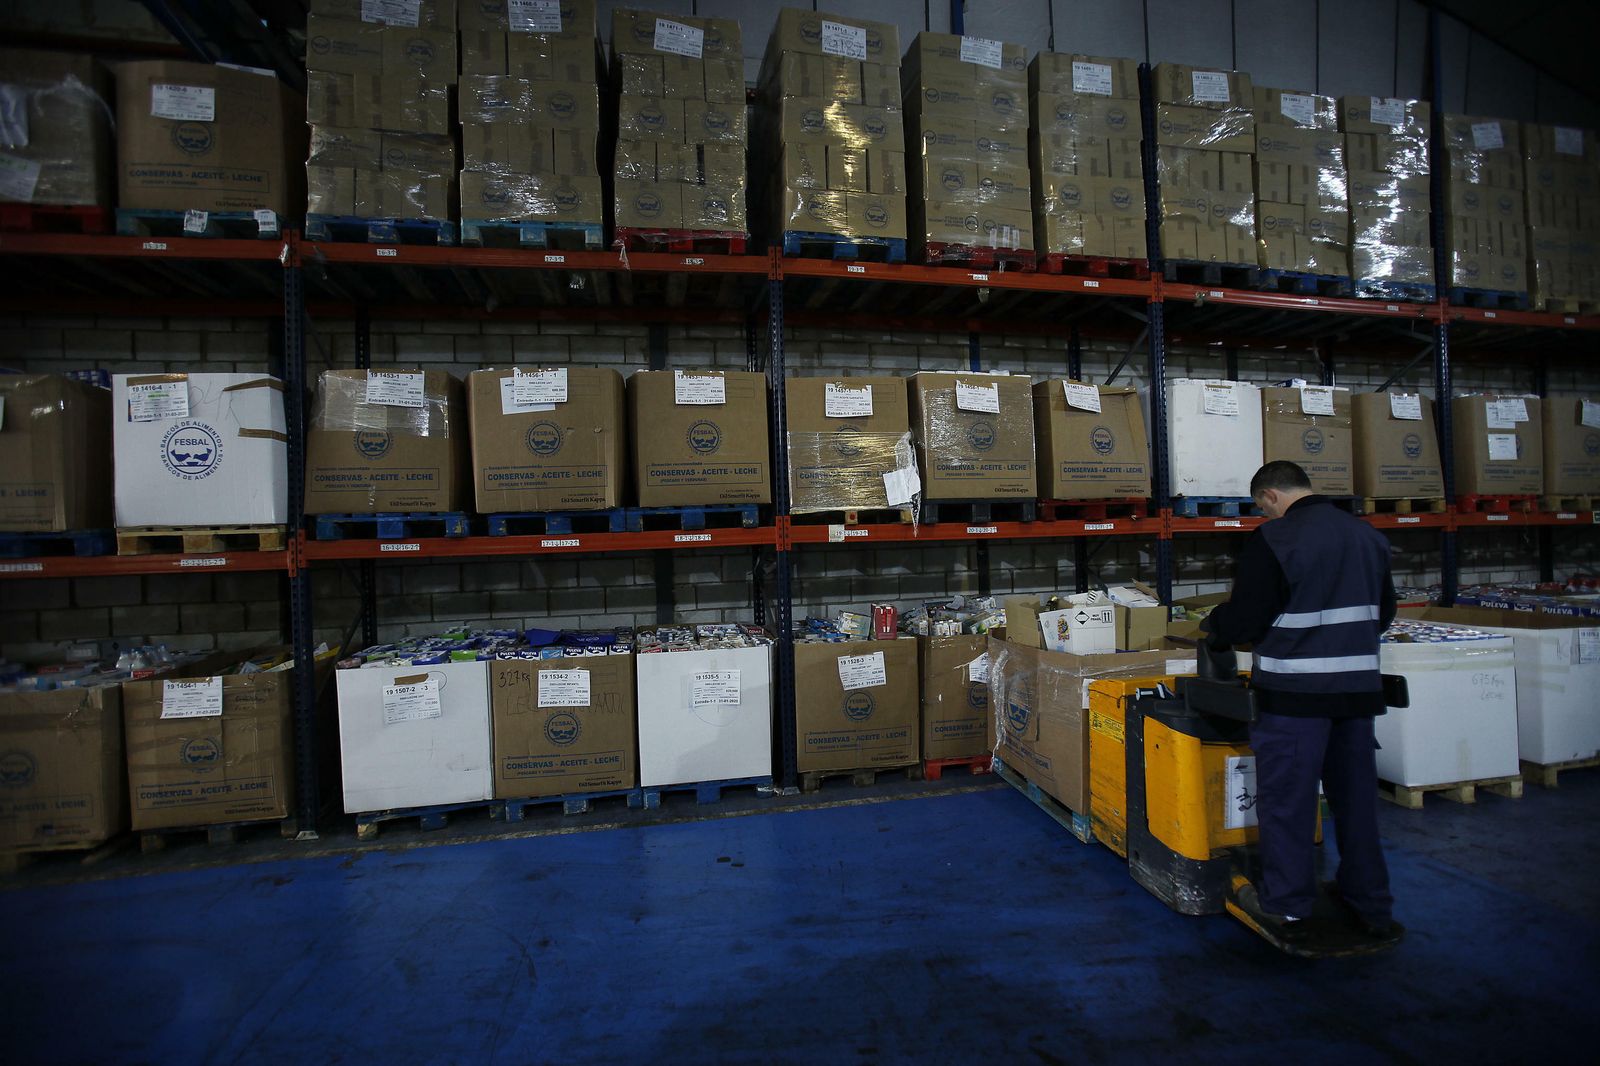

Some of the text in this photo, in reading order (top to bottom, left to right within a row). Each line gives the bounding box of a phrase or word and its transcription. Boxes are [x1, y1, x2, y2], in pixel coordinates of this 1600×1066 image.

[129, 170, 262, 182] CONSERVAS ACEITE LECHE
[160, 425, 180, 448] BANCOS
[193, 421, 223, 448] ALIMENTOS
[160, 455, 180, 477] BANCOS
[194, 454, 223, 480] ALIMENTOS
[650, 469, 696, 477] CONSERVAS
[734, 467, 758, 475] LECHE
[314, 473, 433, 482] CONSERVAS ACEITE LECHE
[487, 470, 603, 481] CONSERVAS ACEITE LECHE
[16, 489, 48, 497] LECHE
[1481, 600, 1509, 609] PULEVA
[1542, 606, 1573, 615] PULEVA
[935, 723, 974, 732] CONSERVAS
[808, 735, 850, 744] CONSERVAS
[506, 756, 620, 770] CONSERVAS ACEITE LECHE
[141, 781, 268, 799] CONSERVAS ACEITE LECHE
